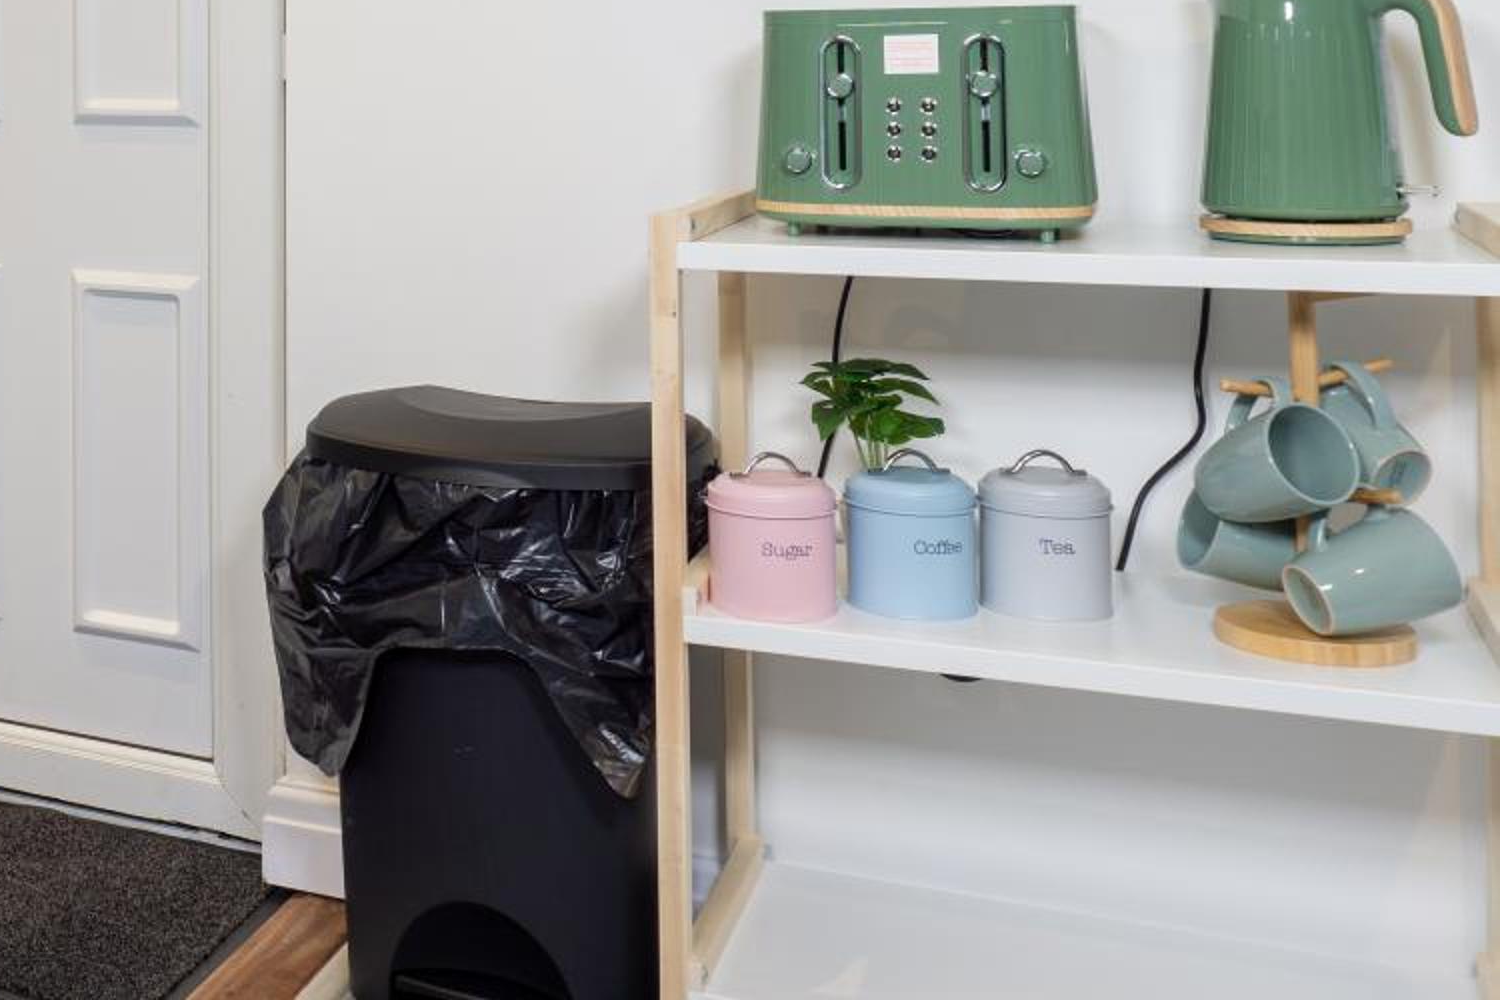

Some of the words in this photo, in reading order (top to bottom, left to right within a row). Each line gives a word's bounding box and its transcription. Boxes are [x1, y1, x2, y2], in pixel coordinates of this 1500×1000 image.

[760, 541, 813, 561] Sugar
[913, 539, 963, 555] Coffee
[1039, 539, 1076, 555] Tea
